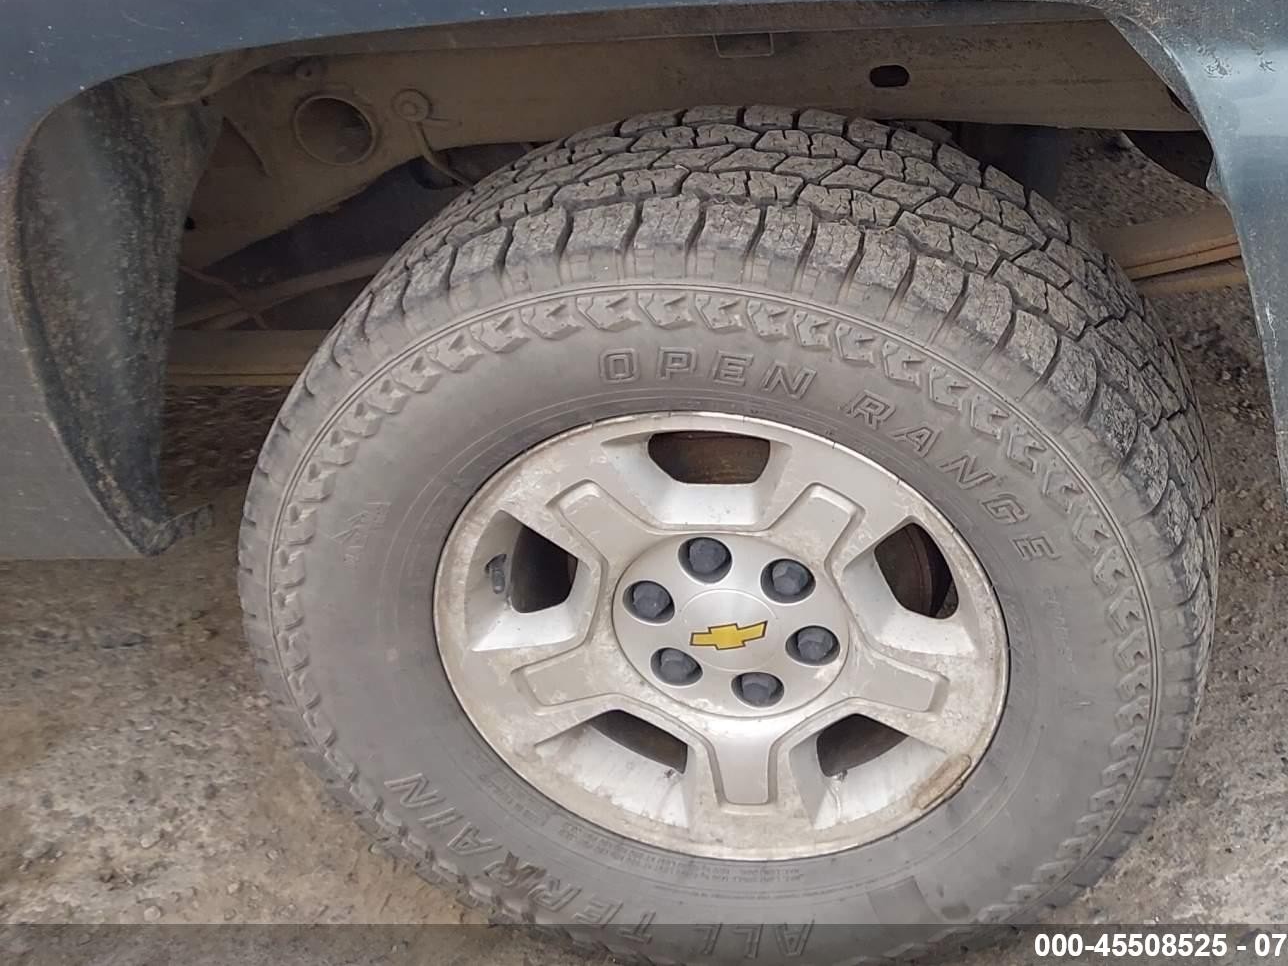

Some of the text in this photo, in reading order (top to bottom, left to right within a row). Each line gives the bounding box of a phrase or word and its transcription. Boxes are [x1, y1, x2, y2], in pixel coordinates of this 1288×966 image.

[601, 348, 1058, 562] OPEN RANGE
[385, 771, 656, 945] TERRAIN
[692, 918, 817, 959] ALL
